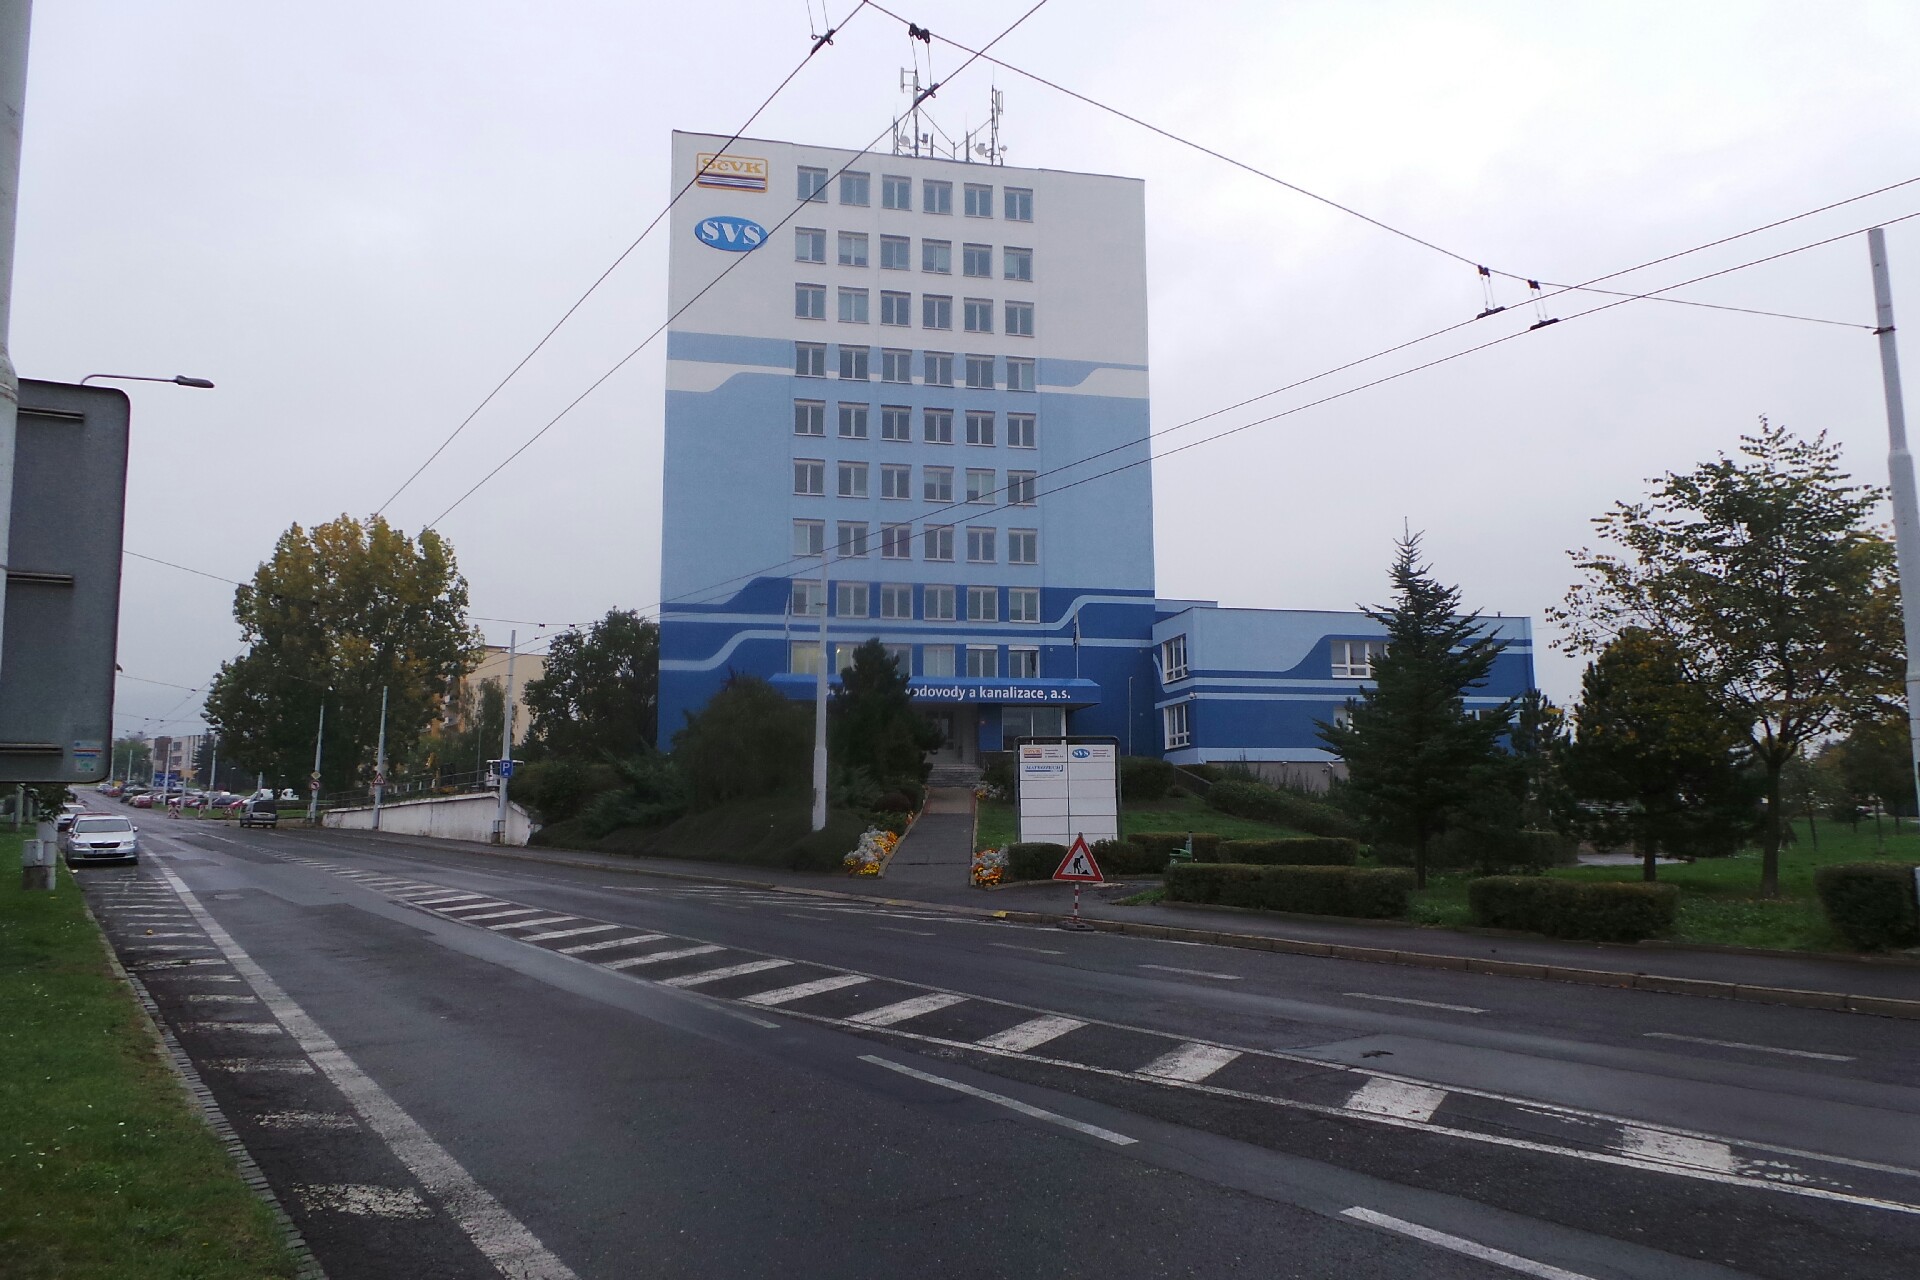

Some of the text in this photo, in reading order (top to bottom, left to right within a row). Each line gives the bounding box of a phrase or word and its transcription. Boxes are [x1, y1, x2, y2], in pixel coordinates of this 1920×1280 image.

[701, 220, 761, 245] SVS
[969, 688, 976, 698] a
[979, 686, 1048, 700] kanalizace,
[1051, 689, 1071, 699] a.s.
[502, 762, 511, 772] P
